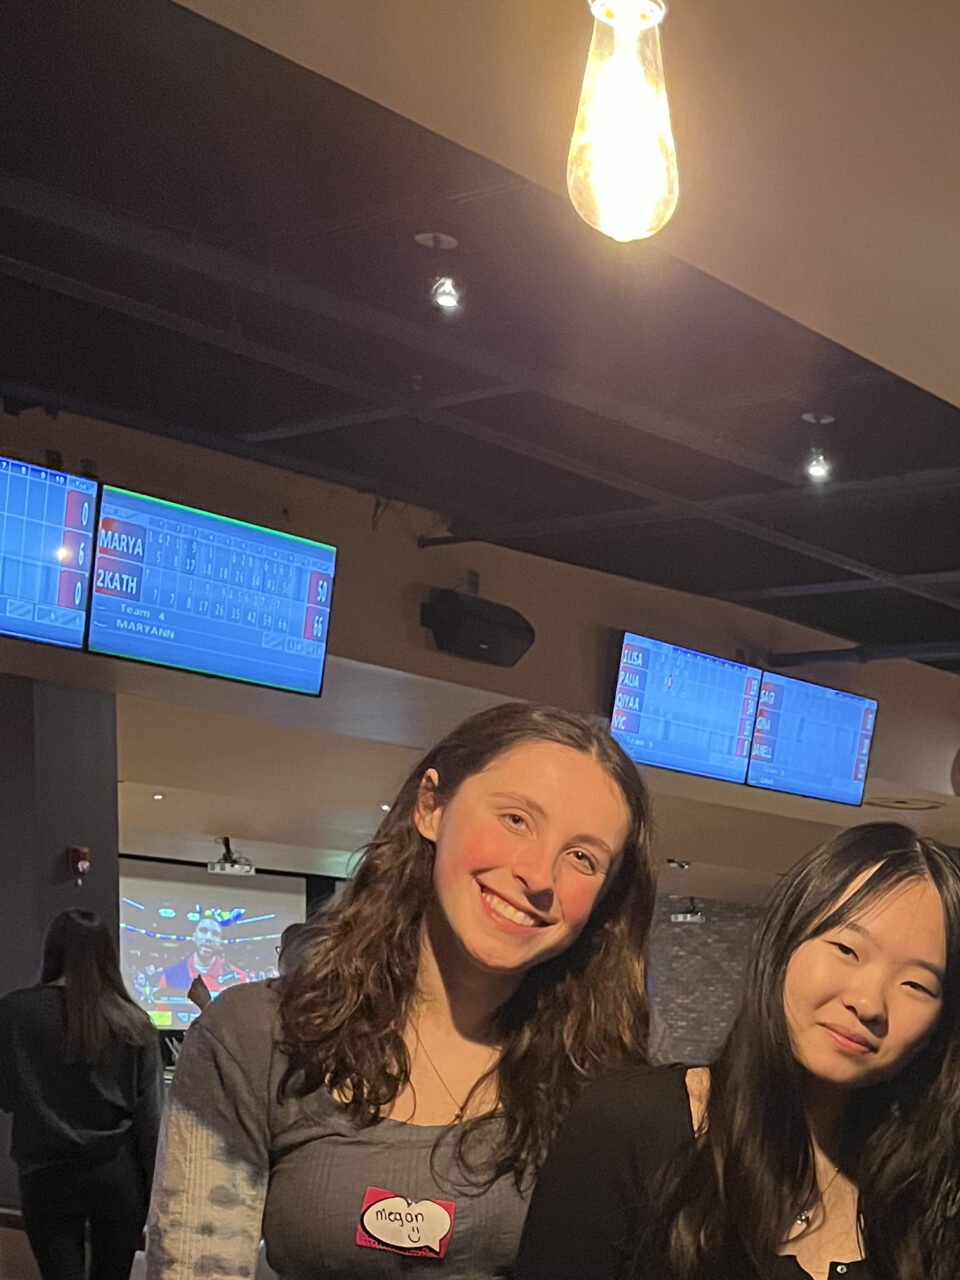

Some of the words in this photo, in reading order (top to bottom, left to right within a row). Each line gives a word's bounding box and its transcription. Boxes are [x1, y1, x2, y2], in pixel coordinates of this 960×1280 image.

[81, 502, 89, 526] 0
[78, 542, 85, 565] 6
[99, 529, 143, 556] MARYA
[74, 581, 82, 605] 0
[96, 569, 137, 594] 2KATH
[120, 603, 151, 619] Team
[158, 612, 165, 621] 4
[116, 619, 175, 639] MARYANN
[313, 616, 323, 637] 66
